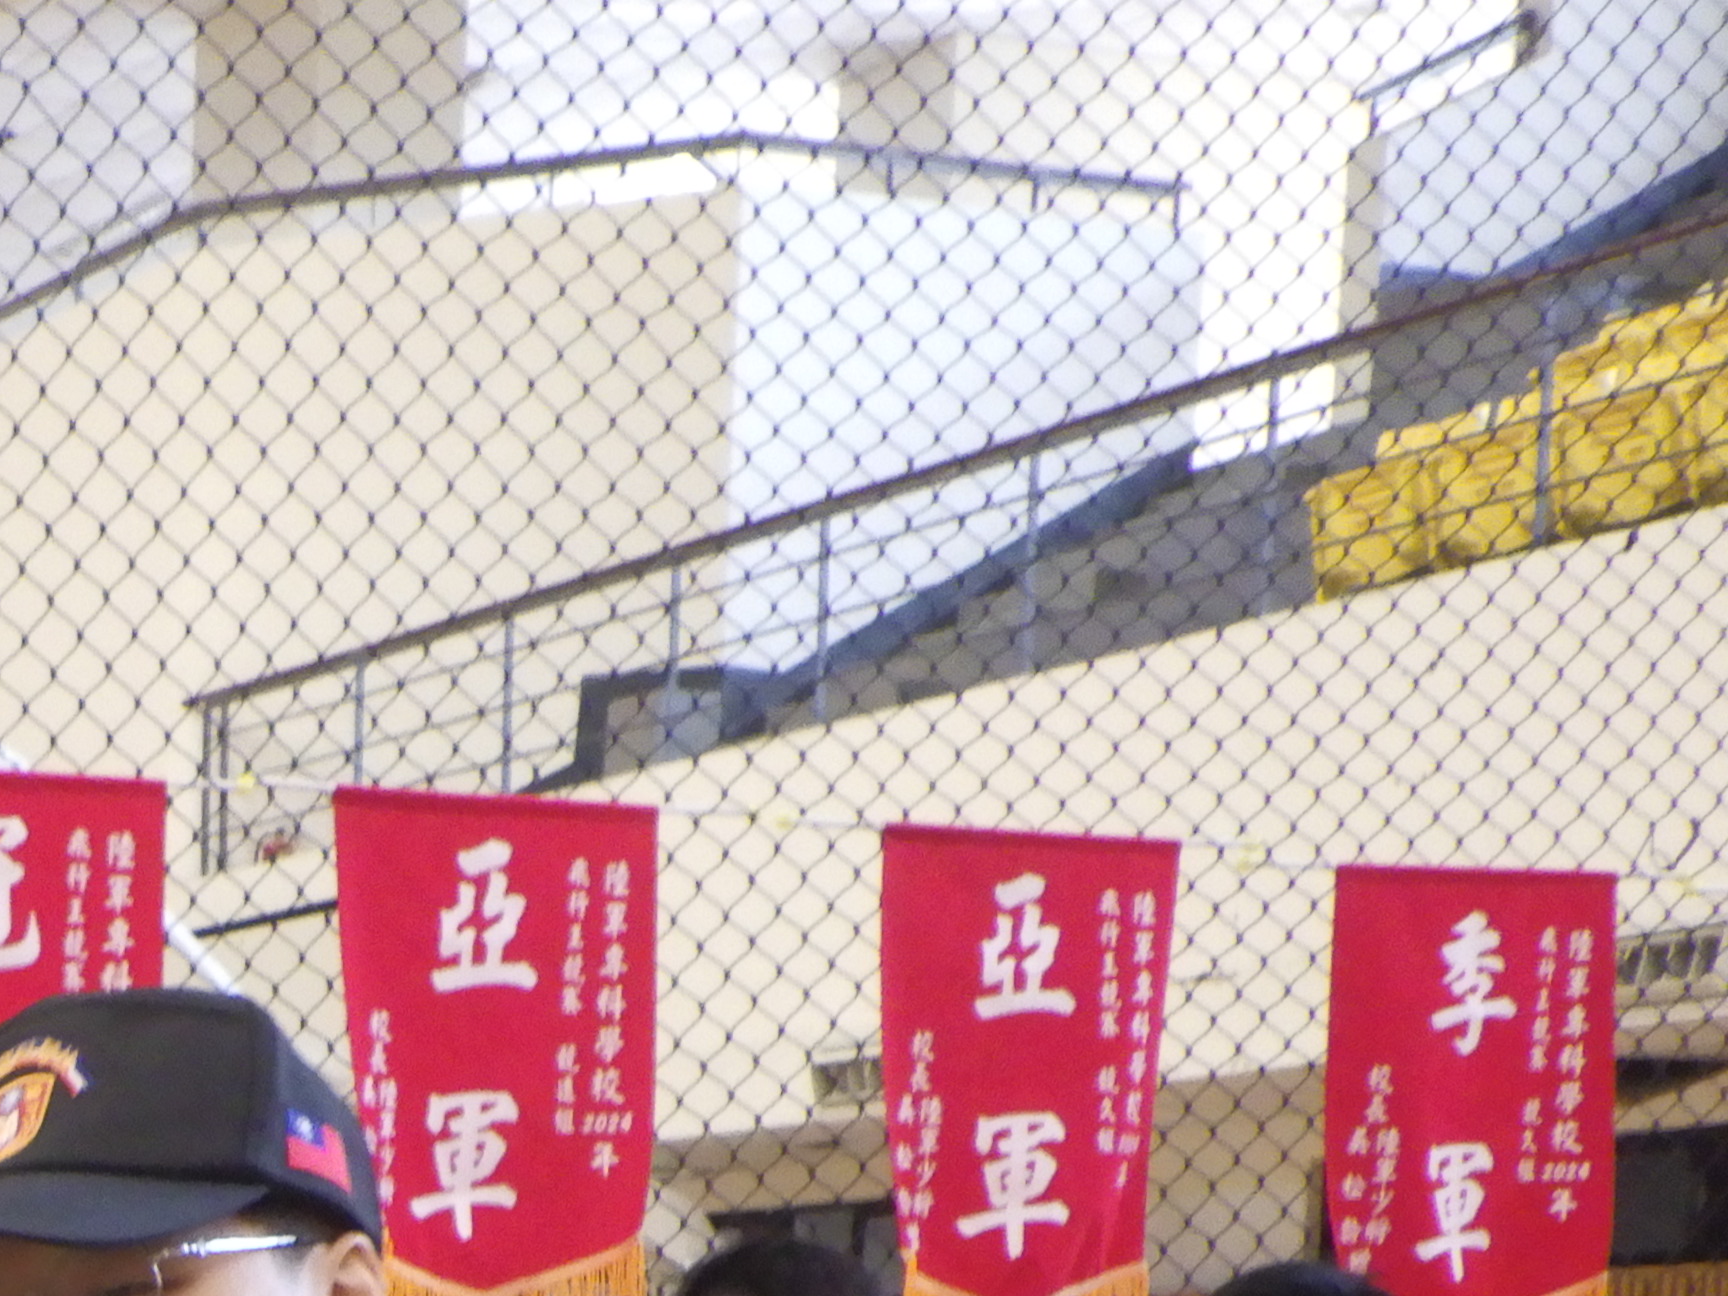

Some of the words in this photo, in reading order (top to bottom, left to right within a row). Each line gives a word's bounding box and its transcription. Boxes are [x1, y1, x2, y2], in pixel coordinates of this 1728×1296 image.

[410, 838, 538, 1240] 亞軍
[957, 872, 1076, 1259] 亞軍
[1416, 911, 1518, 1282] 季軍
